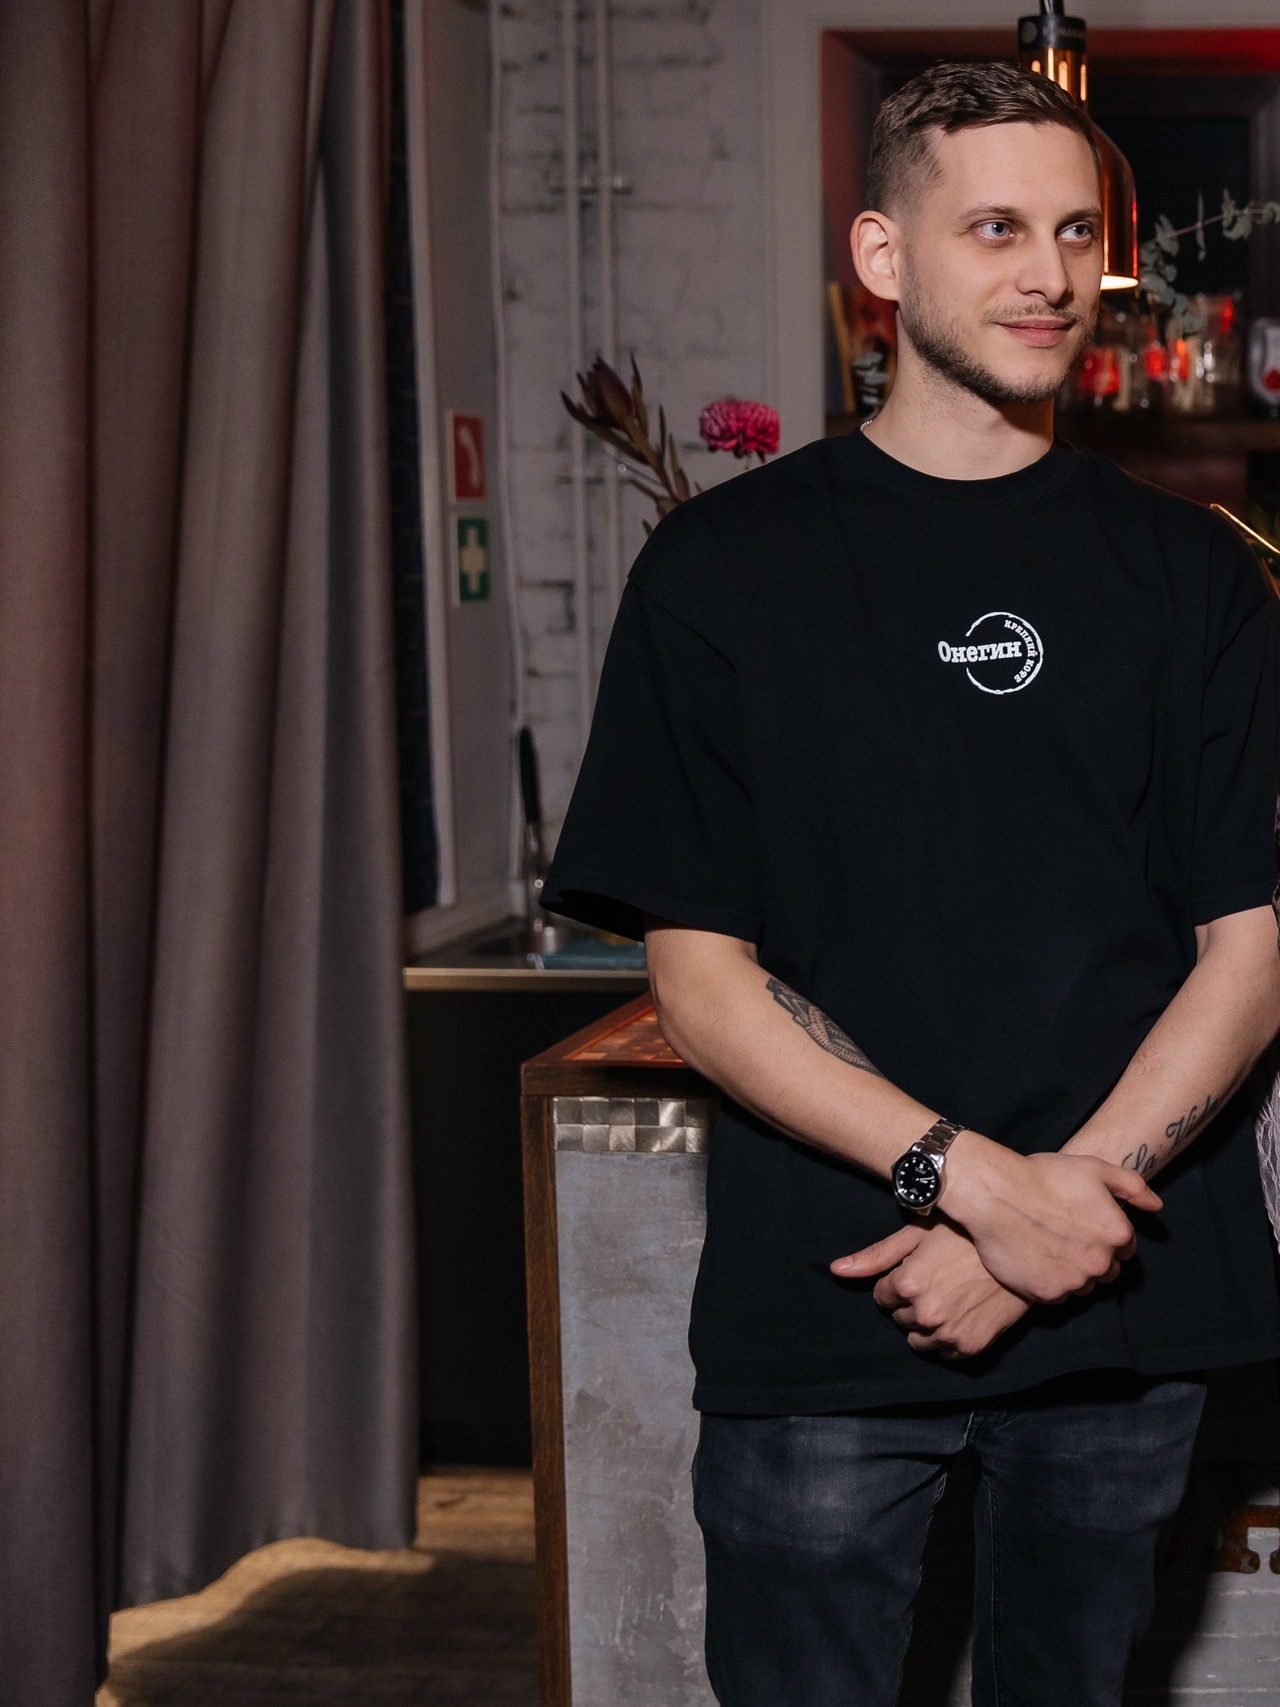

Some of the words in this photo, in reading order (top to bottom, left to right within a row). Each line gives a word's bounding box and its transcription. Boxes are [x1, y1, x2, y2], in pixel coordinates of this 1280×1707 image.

[1004, 619, 1038, 658] КРЕПКИЙ
[938, 640, 1022, 663] Онегин
[1014, 659, 1034, 683] КОФЕ
